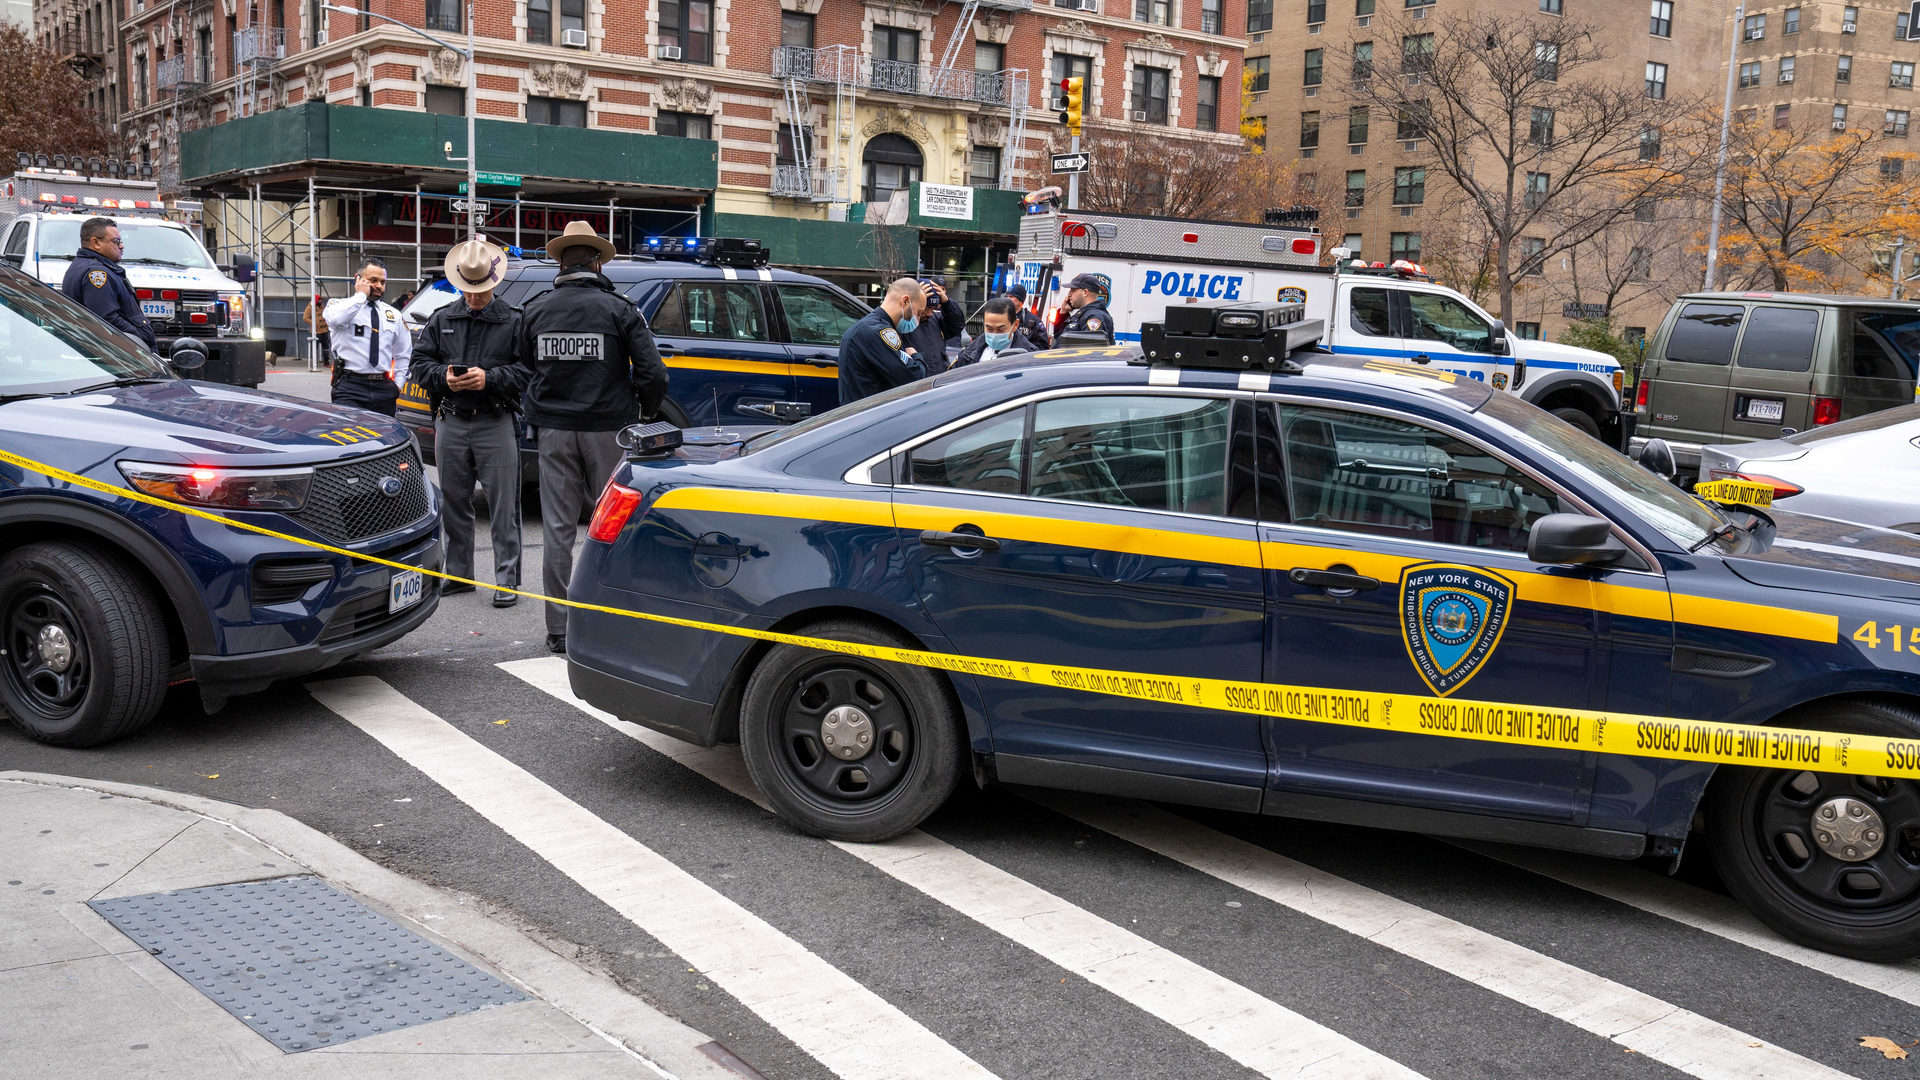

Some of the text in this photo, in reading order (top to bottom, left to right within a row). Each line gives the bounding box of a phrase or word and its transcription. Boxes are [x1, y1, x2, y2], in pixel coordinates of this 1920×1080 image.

[934, 197, 960, 205] CONSTRUCTION
[1020, 280, 1043, 294] POLI
[1141, 270, 1243, 300] POLICE
[143, 304, 165, 314] 5735
[542, 338, 599, 356] TROOPER
[1578, 363, 1605, 374] POLICE
[1751, 404, 1780, 414] VYX-7091
[1714, 484, 1729, 499] LINE
[1729, 485, 1738, 501] DO
[1738, 487, 1755, 503] NOT
[402, 575, 420, 598] 406
[1408, 574, 1505, 600] NEW YORK STATE
[1407, 590, 1421, 648] TRIBOROUGH
[1416, 649, 1438, 681] BRIDGE
[1448, 656, 1480, 682] TUNNEL
[1478, 602, 1504, 654] AUTHORITY
[895, 652, 928, 666] CROSS
[926, 656, 946, 669] NOT
[945, 658, 962, 671] DO
[958, 660, 979, 674] LINE
[980, 662, 1016, 678] POLICE
[1051, 670, 1086, 688] CROSS
[1086, 674, 1107, 690] NOT
[1107, 676, 1123, 693] DO
[1122, 678, 1147, 697] LINE
[1146, 680, 1183, 701] POLICE
[1225, 686, 1260, 710] CROSS
[1263, 690, 1284, 713] NOT
[1286, 692, 1300, 715] DO
[1304, 694, 1328, 718] LINE
[1331, 696, 1370, 722] POLICE
[1419, 702, 1456, 731] CROSS
[1461, 706, 1483, 734] NOT
[1487, 708, 1503, 736] DO
[1507, 710, 1533, 738] LINE
[1537, 713, 1580, 743] POLICE
[1637, 720, 1680, 752] CROSS
[1684, 725, 1710, 754] NOT
[1715, 727, 1733, 756] DO
[1737, 729, 1767, 759] LINE
[1772, 732, 1821, 763] POLICE
